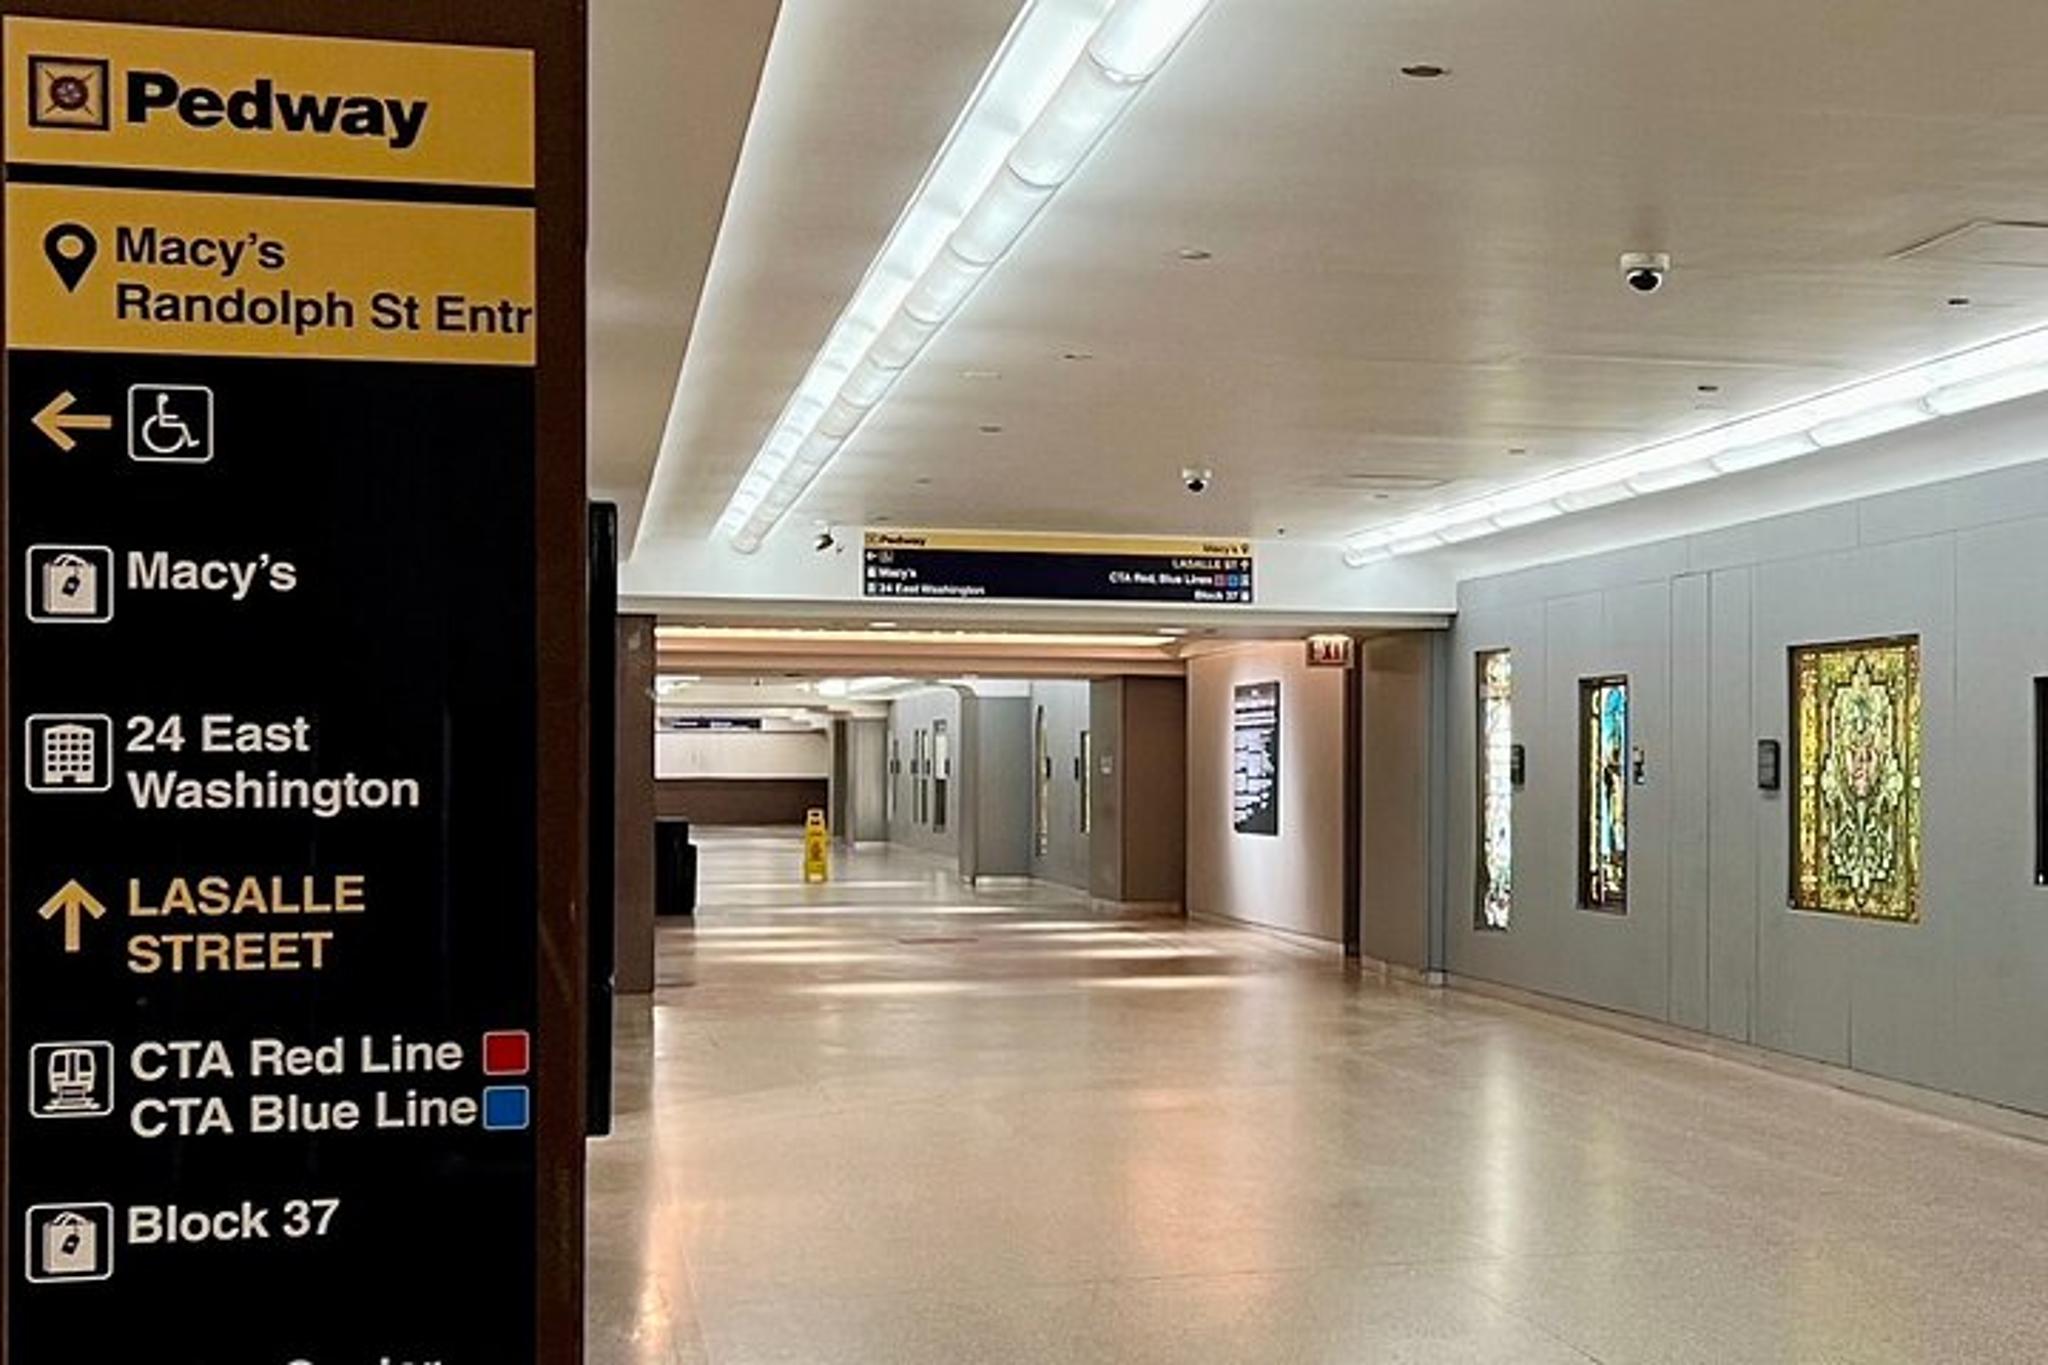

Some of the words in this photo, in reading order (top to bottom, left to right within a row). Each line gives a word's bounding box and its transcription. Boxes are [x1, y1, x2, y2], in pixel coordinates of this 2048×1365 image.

[126, 70, 429, 149] Pedway
[116, 226, 285, 277] Macy’s
[116, 282, 354, 336] Randolph
[370, 292, 420, 331] St
[436, 295, 533, 334] Entr
[879, 534, 926, 547] Pedway
[128, 551, 297, 601] Macy’s
[895, 582, 919, 593] East
[921, 584, 985, 598] Washington
[1108, 571, 1131, 584] CTA
[1158, 573, 1182, 585] Blue
[1183, 573, 1213, 585] Lines
[1194, 590, 1223, 601] Block
[126, 714, 186, 752] 24
[202, 714, 310, 753] East
[127, 770, 419, 818] Washington
[128, 875, 365, 916] LASALLE
[127, 931, 334, 973] STREET
[130, 1040, 234, 1081] CTA
[250, 1036, 344, 1077] Red
[361, 1034, 463, 1073] Line
[130, 1096, 234, 1138] CTA
[250, 1094, 360, 1133] Blue
[376, 1089, 478, 1128] Line
[128, 1200, 269, 1244] Block
[283, 1198, 340, 1238] 37
